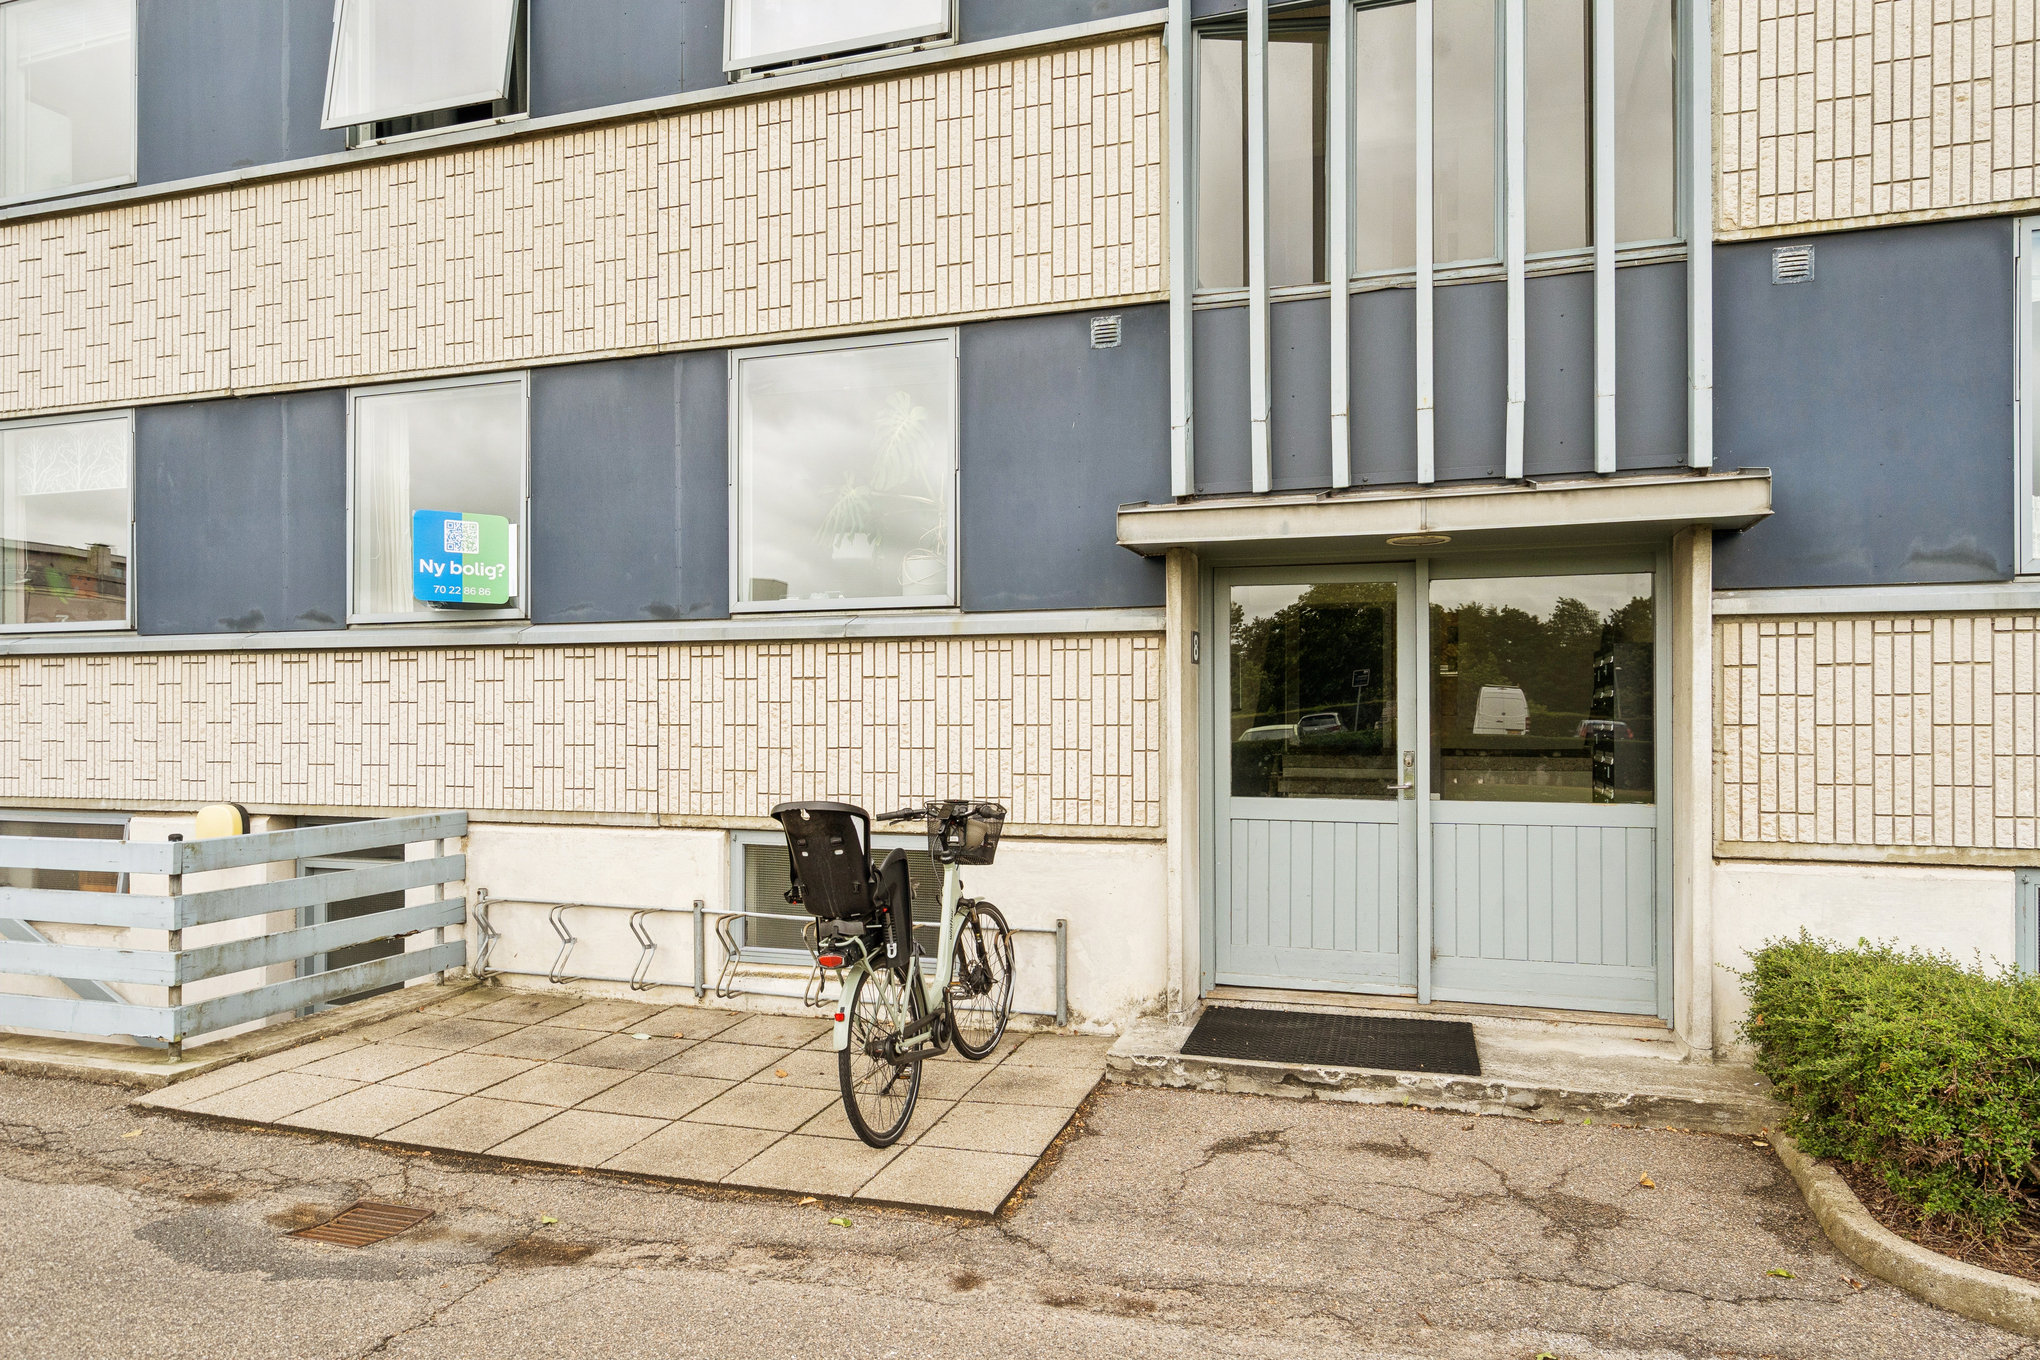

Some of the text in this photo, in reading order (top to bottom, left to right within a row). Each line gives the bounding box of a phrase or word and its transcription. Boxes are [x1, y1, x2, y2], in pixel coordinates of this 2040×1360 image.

[419, 558, 506, 580] Ny bolig?
[433, 585, 491, 596] 70 22 86 86
[1193, 634, 1199, 661] 8
